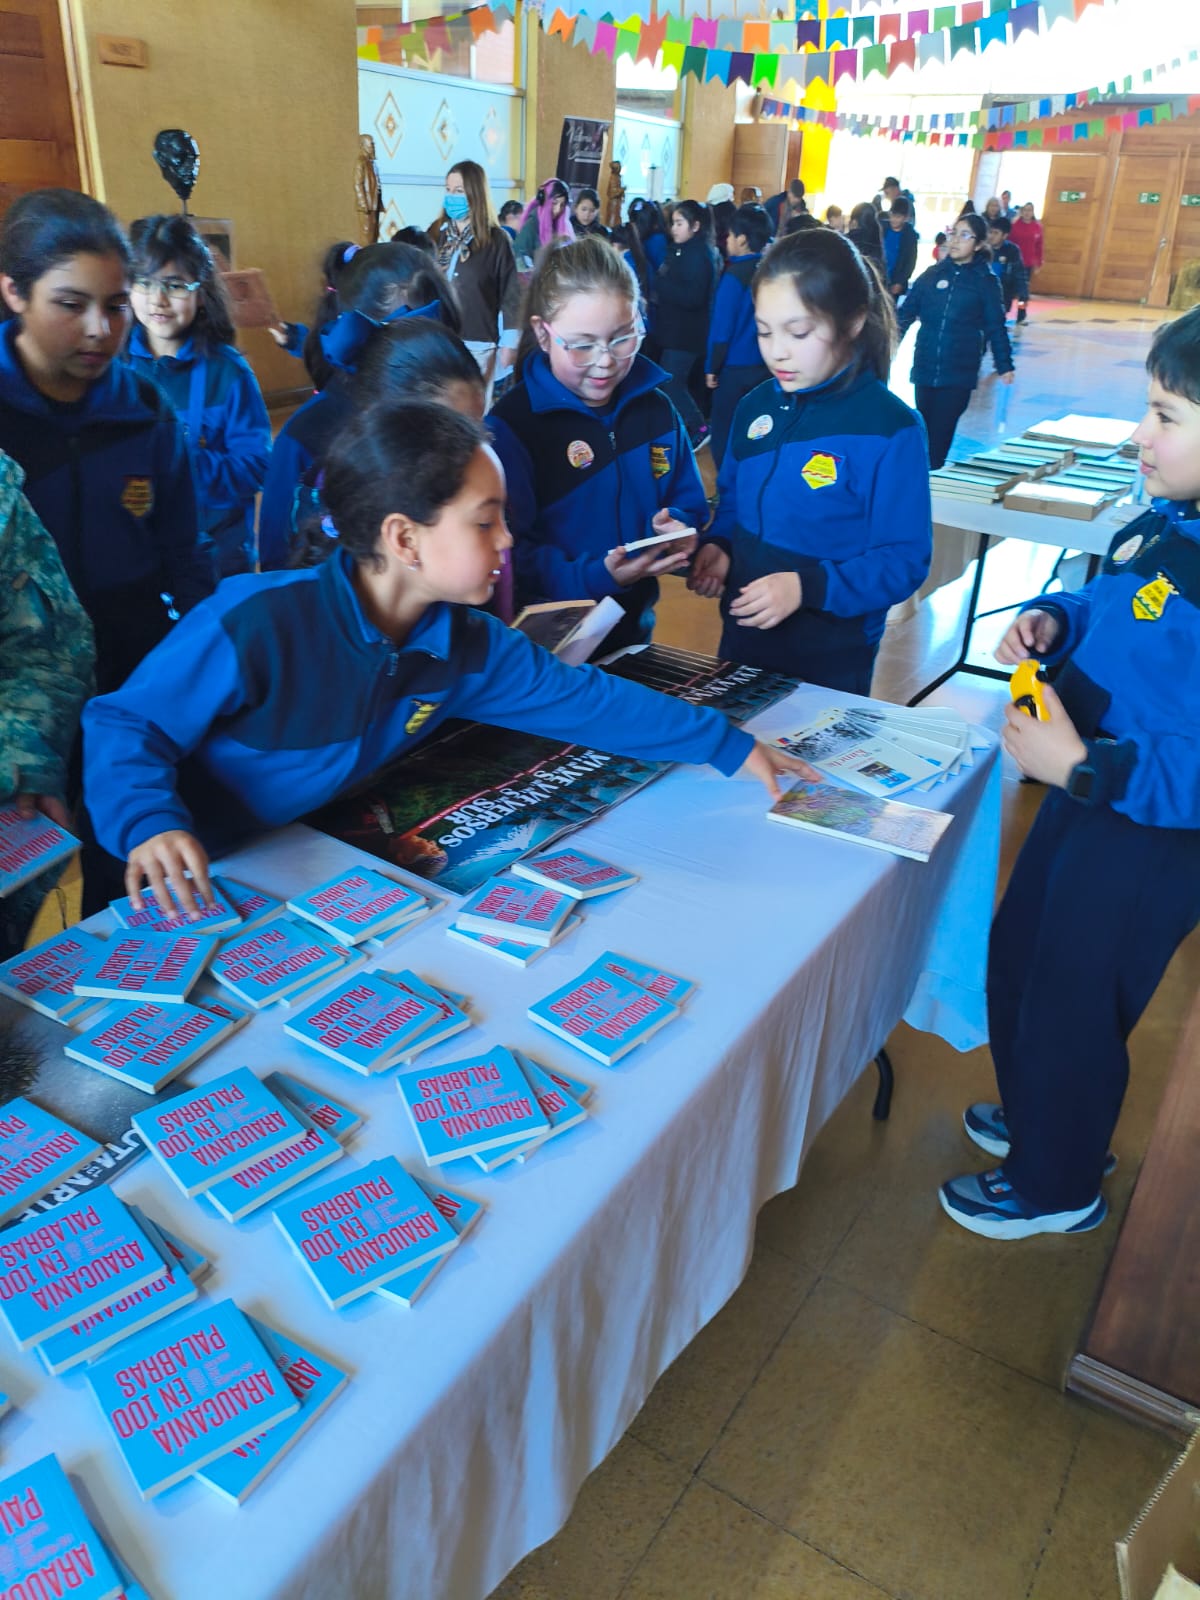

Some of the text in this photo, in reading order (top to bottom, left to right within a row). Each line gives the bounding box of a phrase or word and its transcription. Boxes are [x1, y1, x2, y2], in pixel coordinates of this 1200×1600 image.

[438, 799, 526, 848] VERSOS
[443, 797, 495, 825] SUR
[307, 875, 368, 908] PALABRAS
[315, 897, 361, 922] EN 100
[10, 939, 83, 979] PALABRAS
[95, 939, 145, 980] PALABRAS
[218, 929, 286, 965] PALABRAS
[223, 953, 274, 982] EN 100
[16, 975, 51, 995] 100
[43, 964, 71, 979] EN
[117, 959, 158, 990] EN 100
[307, 984, 376, 1030] PALABRAS
[550, 977, 613, 1018] PALABRAS
[594, 993, 661, 1040] ARAUCANÍA
[90, 1002, 163, 1051] PALABRAS
[138, 1013, 215, 1066] ARAUCANÍA
[319, 1012, 371, 1049] EN 100
[352, 998, 425, 1050] ARAUCANÍA
[561, 1003, 610, 1036] EN 100
[102, 1031, 157, 1068] EN 100
[417, 1062, 501, 1098] PALABRAS
[156, 1083, 246, 1134] PALABRAS
[412, 1091, 472, 1123] EN 100
[440, 1097, 533, 1140] ARAUCANÍA
[95, 1128, 141, 1169] UTA
[156, 1118, 221, 1159] EN 100
[190, 1110, 288, 1167] ARAUCANÍA
[301, 1175, 394, 1232] PALABRAS
[0, 1205, 102, 1268] PALABRAS
[300, 1216, 370, 1262] EN 100
[336, 1210, 440, 1276] ARAUCANÍA
[0, 1251, 69, 1300] EN 100
[31, 1240, 145, 1312] ARAUCANÍA
[115, 1323, 226, 1398] PALABRAS
[111, 1377, 193, 1439] EN 100
[152, 1369, 276, 1456] ARAUCANÍA
